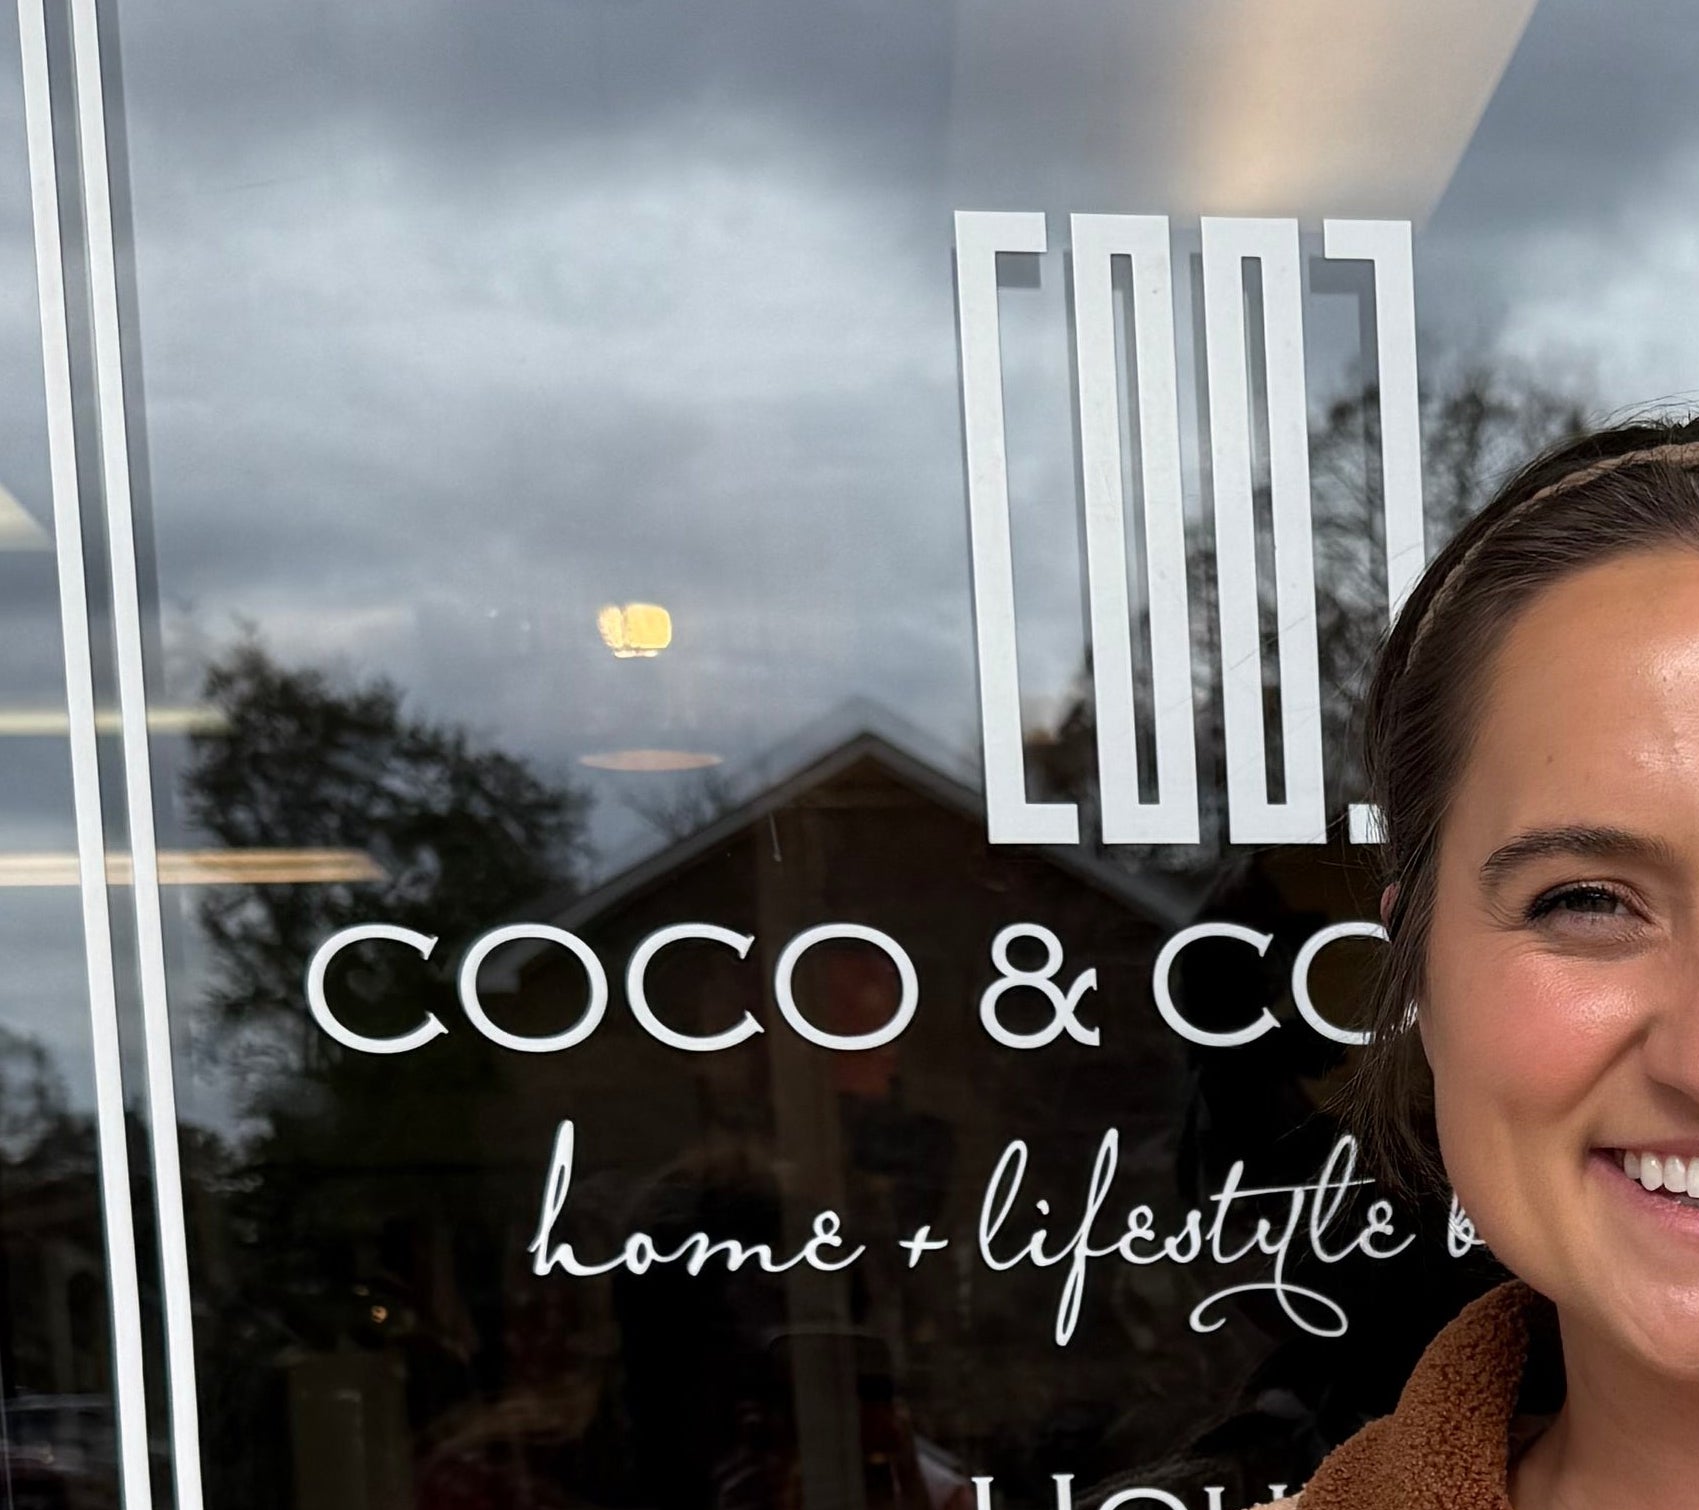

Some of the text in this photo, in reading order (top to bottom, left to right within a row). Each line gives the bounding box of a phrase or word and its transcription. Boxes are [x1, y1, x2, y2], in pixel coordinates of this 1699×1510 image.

[306, 923, 918, 1054] COCO
[979, 922, 1100, 1048] &
[528, 1119, 866, 1277] home
[899, 1225, 949, 1268] +
[979, 1127, 1415, 1346] lifestyle
